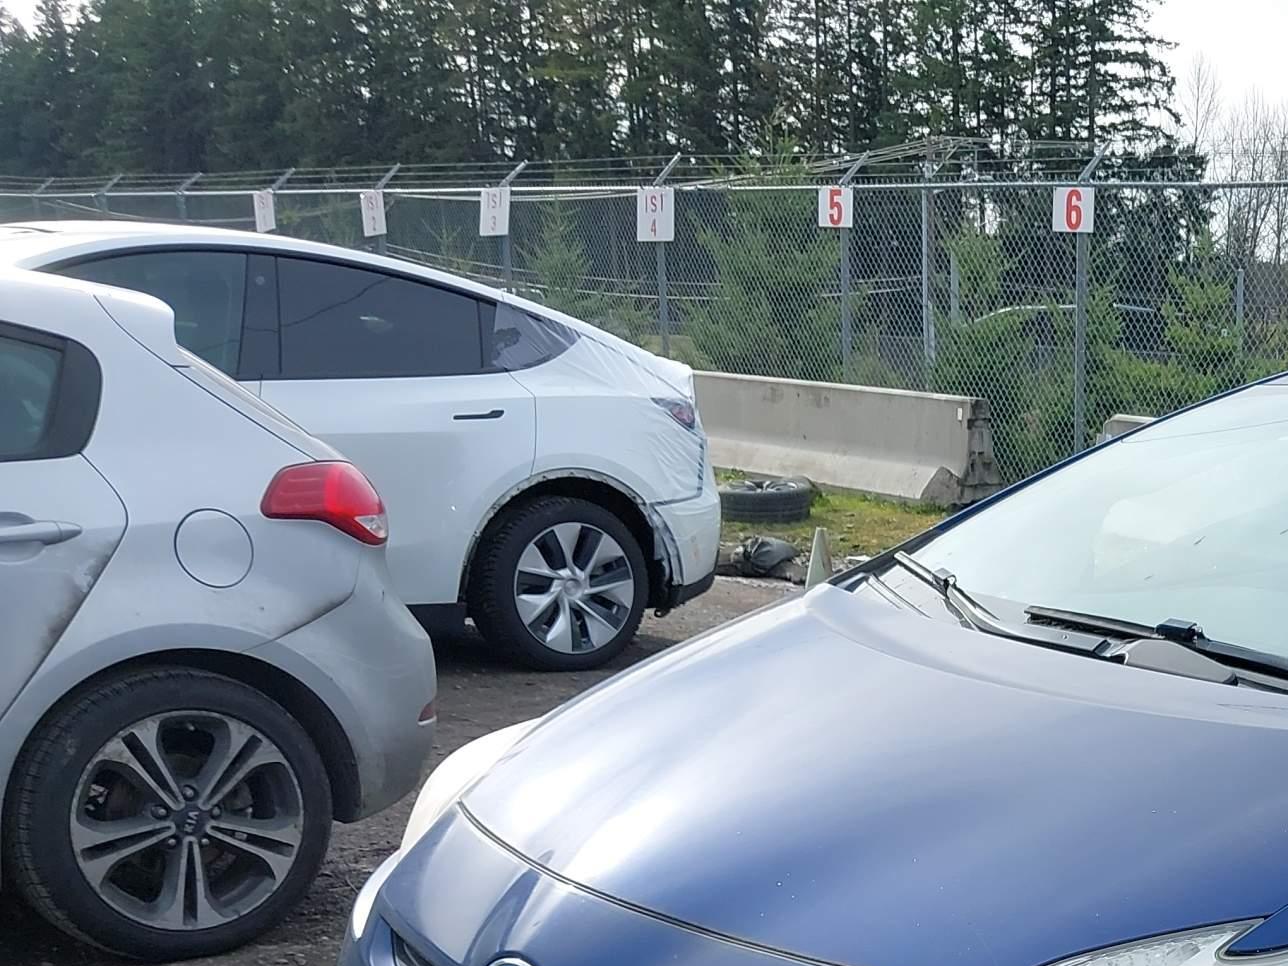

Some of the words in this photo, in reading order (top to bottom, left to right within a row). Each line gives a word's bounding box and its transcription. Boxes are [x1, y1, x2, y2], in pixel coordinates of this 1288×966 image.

[829, 188, 843, 226] 5
[1066, 189, 1082, 230] 6
[650, 218, 657, 237] 4
